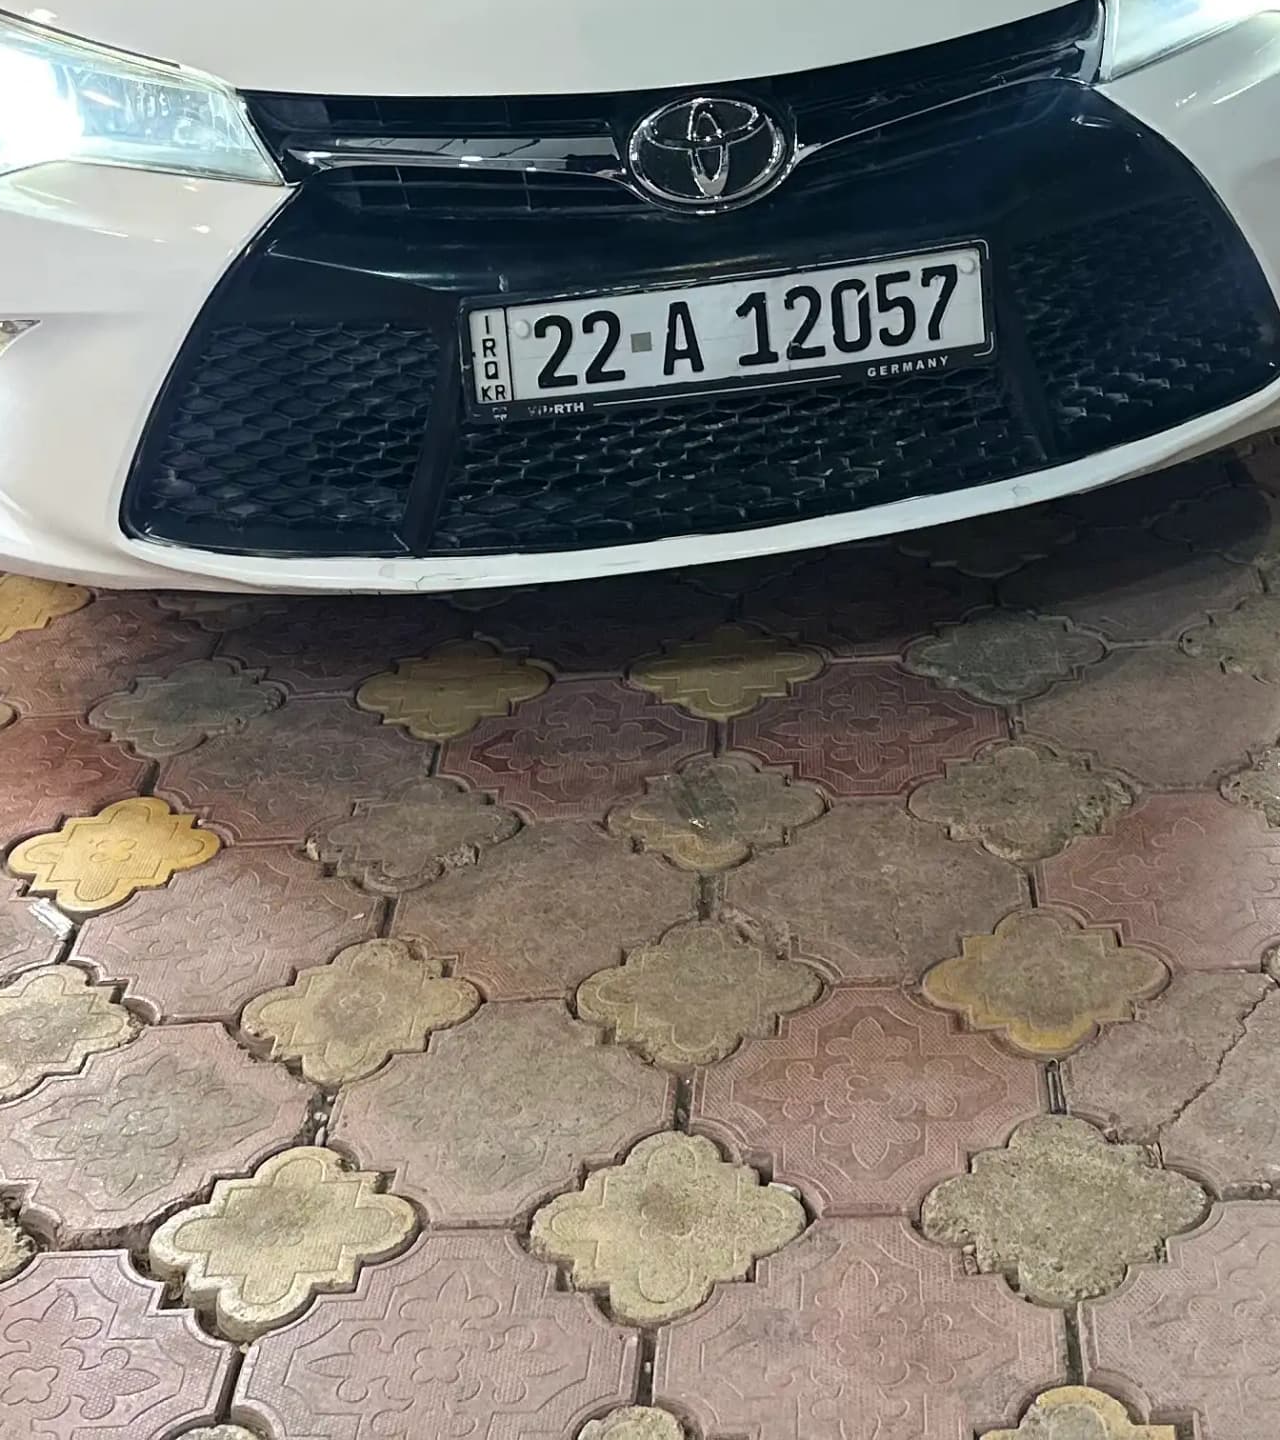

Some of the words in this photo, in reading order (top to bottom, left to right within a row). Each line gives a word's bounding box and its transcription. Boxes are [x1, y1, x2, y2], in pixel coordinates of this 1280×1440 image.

[534, 310, 626, 389] 22
[663, 301, 705, 377] A
[735, 264, 959, 367] 12057
[867, 355, 949, 377] GERMANY
[481, 384, 506, 401] KR
